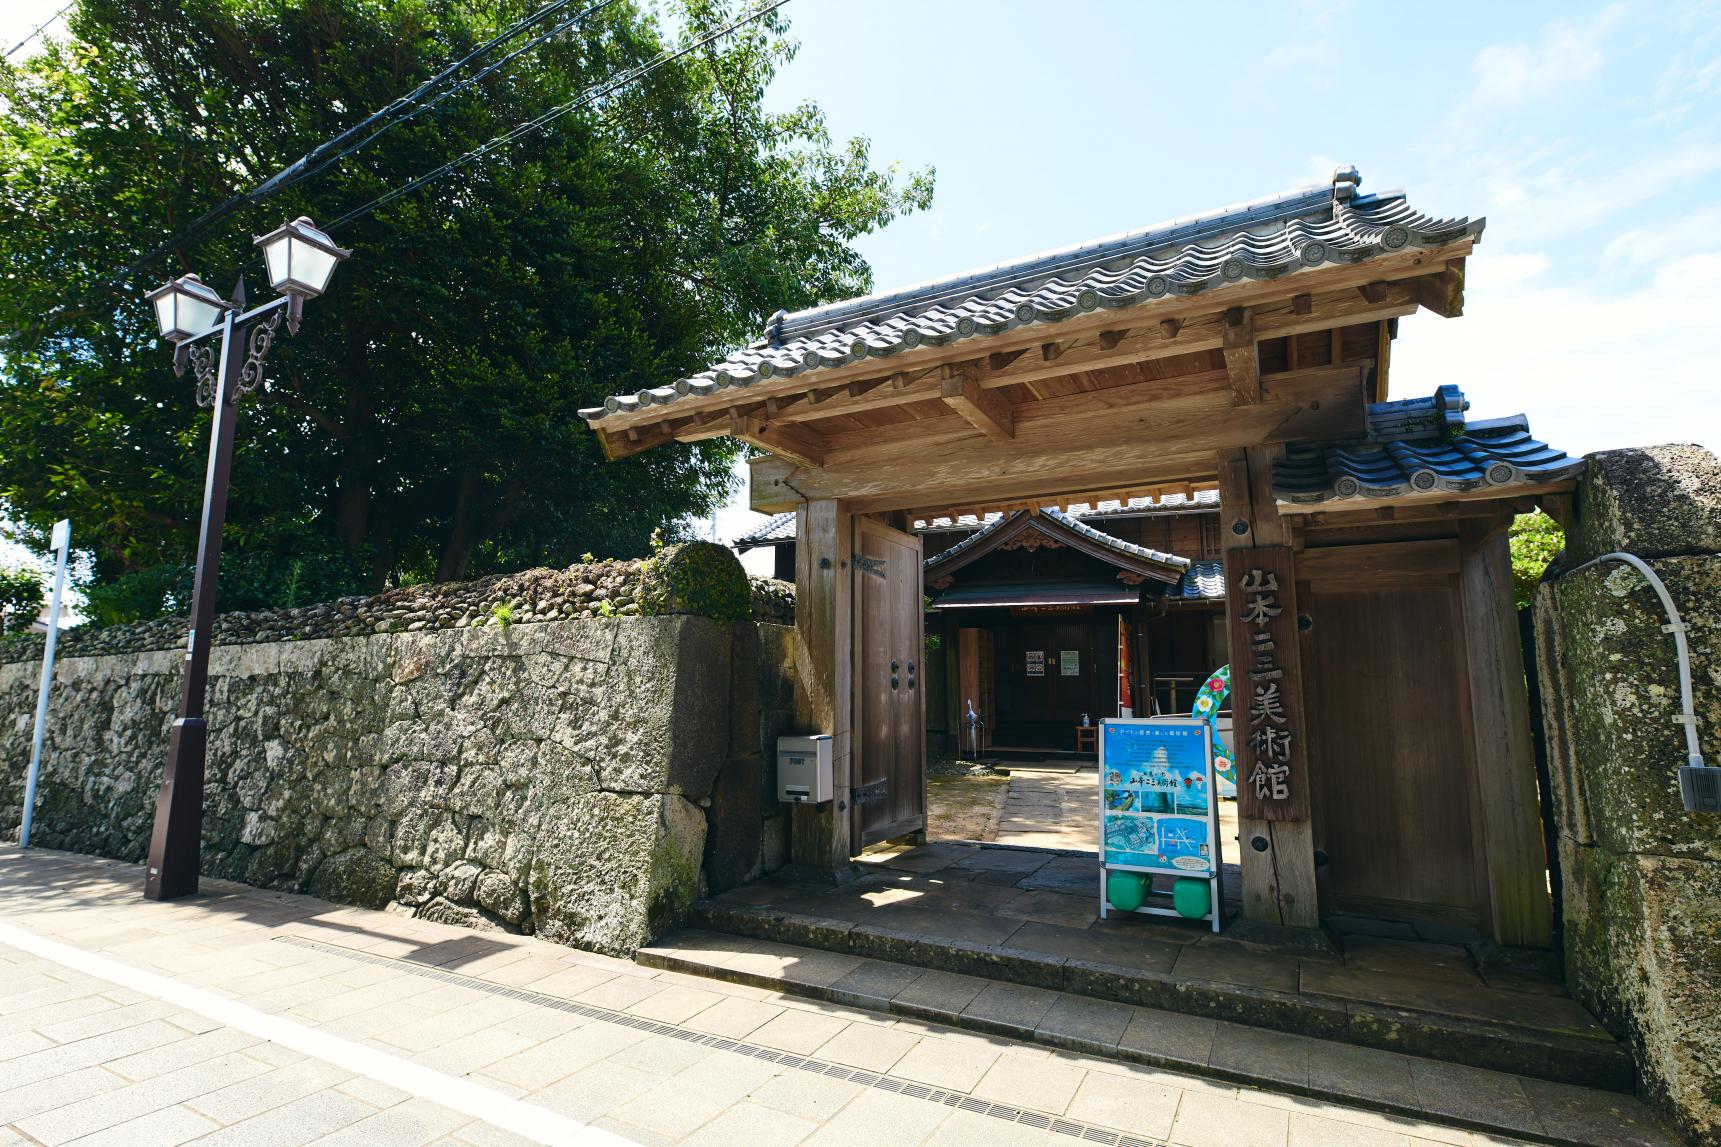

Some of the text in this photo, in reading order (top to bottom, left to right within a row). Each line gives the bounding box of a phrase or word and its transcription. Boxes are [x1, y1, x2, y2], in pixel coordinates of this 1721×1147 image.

[1239, 569, 1292, 800] 山本二三美術館
